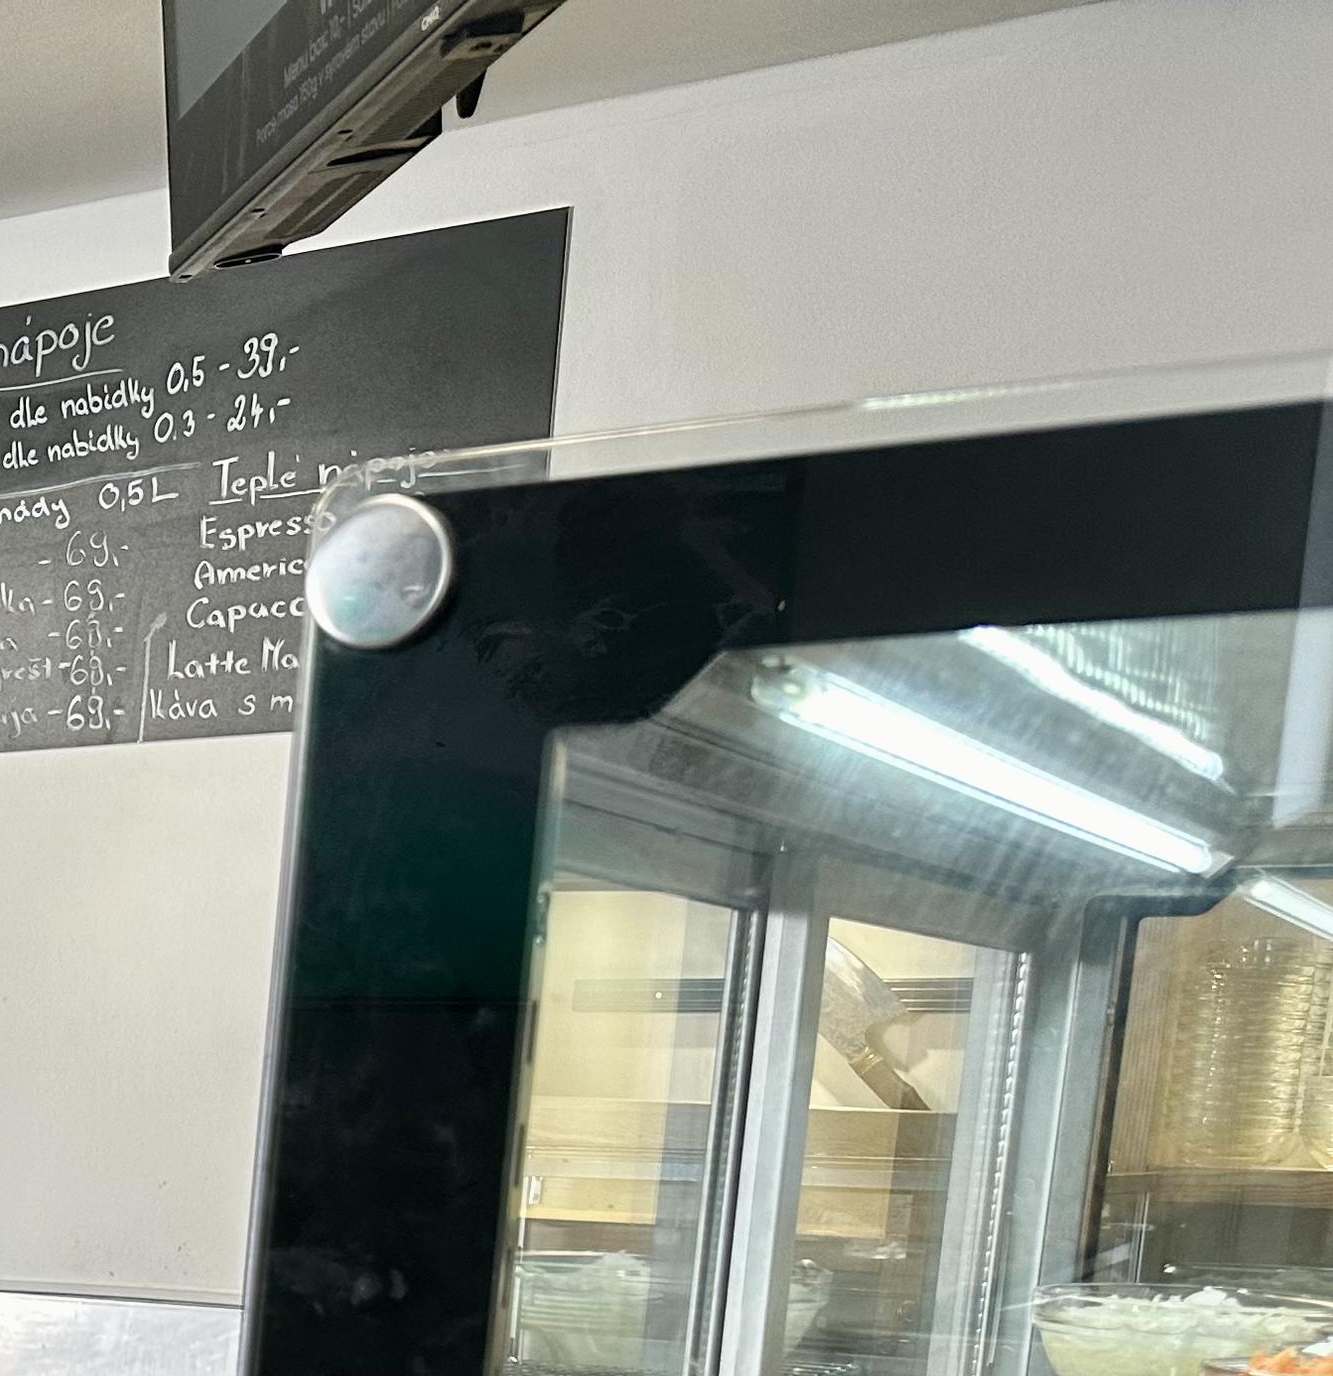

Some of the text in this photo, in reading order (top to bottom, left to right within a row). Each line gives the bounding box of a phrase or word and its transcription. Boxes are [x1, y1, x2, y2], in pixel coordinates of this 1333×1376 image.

[211, 450, 301, 506] Teplé
[185, 597, 307, 633] Capacc
[167, 638, 251, 681] Latte
